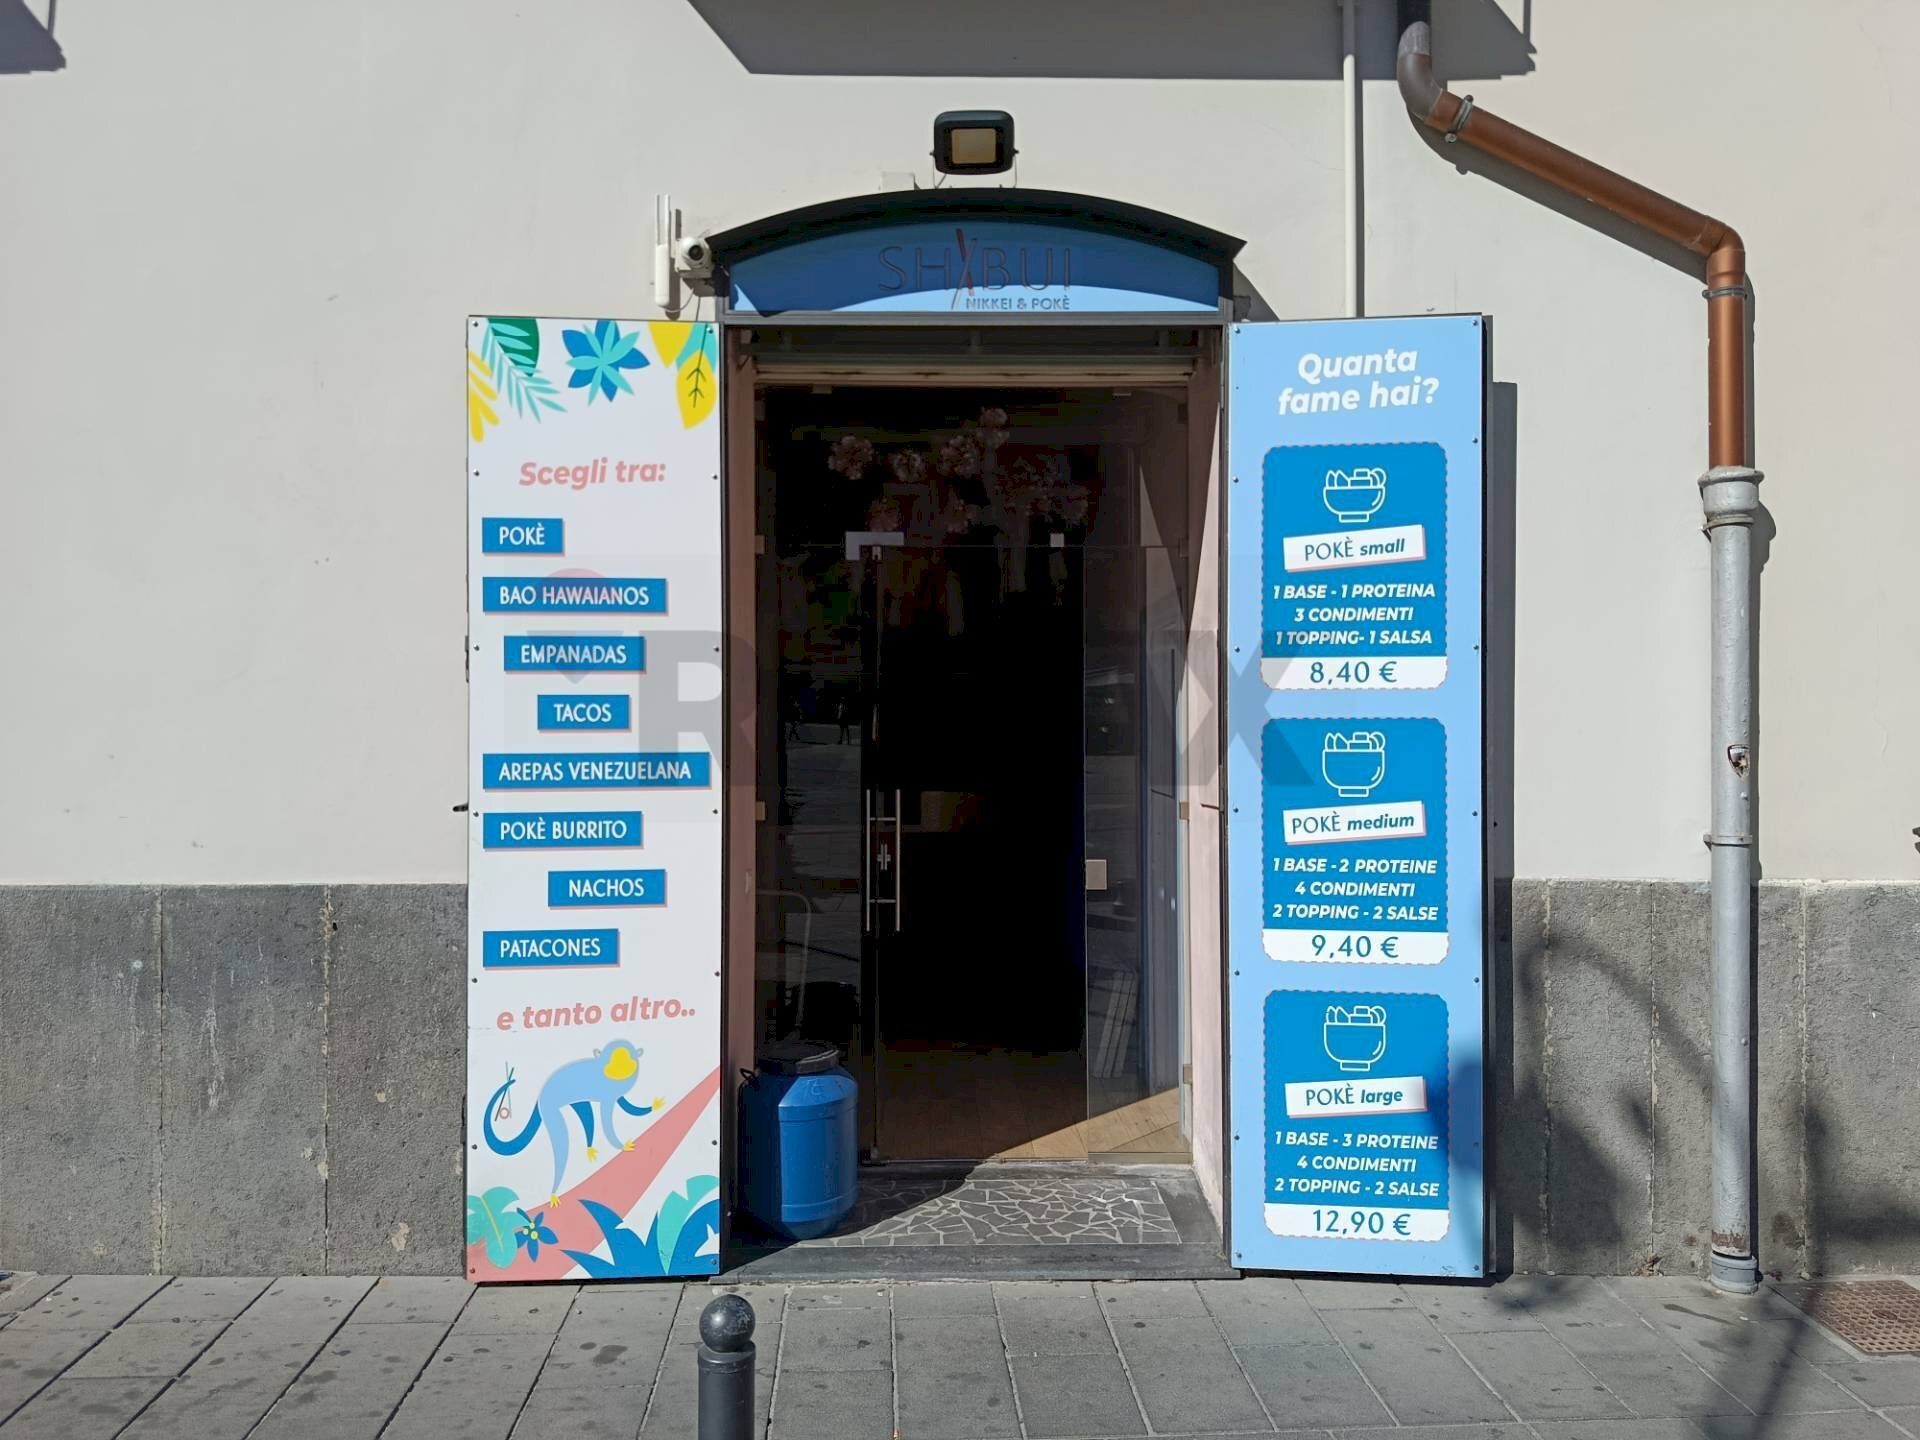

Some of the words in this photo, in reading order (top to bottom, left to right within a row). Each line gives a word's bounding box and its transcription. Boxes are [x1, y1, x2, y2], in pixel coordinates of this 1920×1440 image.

[966, 298, 1012, 309] NIKKEI
[1017, 298, 1027, 309] &
[1032, 295, 1070, 309] POKÈ
[1298, 348, 1417, 384] Quanta
[1278, 387, 1360, 415] fame
[1369, 377, 1440, 408] hai?
[519, 457, 607, 490] Scegli
[616, 460, 666, 483] tra:
[499, 523, 545, 545] POKÈ
[1305, 537, 1354, 561] POKÈ
[1360, 539, 1405, 556] small
[500, 587, 535, 605] BAO
[543, 586, 649, 606] HAWAIANOS
[1273, 585, 1280, 599] 1
[1283, 584, 1327, 599] BASE
[1341, 584, 1348, 598] 1
[1352, 584, 1435, 598] PROTEINA
[1295, 608, 1304, 622] 3
[1308, 607, 1414, 621] CONDIMENTI
[1276, 632, 1283, 645] 1
[1369, 630, 1376, 644] 1
[1380, 630, 1432, 644] SALSA
[521, 644, 627, 664] EMPANADAS
[1310, 661, 1370, 685] 8,40
[1379, 661, 1398, 682] €
[554, 703, 611, 722] TACOS
[499, 762, 563, 781] AREPAS
[569, 761, 691, 781] VENEZUELANA
[500, 817, 546, 840] POKÈ
[552, 820, 627, 839] BURRITO
[1292, 811, 1340, 834] POKÈ
[1348, 814, 1414, 831] medium
[1273, 858, 1280, 871] 1
[1284, 858, 1327, 872] BASE
[1339, 859, 1349, 872] 2
[1355, 859, 1438, 874] PROTEINE
[569, 878, 644, 898] NACHOS
[1295, 882, 1306, 895] 4
[1310, 882, 1415, 896] CONDIMENTI
[1272, 904, 1282, 917] 2
[1287, 904, 1359, 919] TOPPING
[1373, 906, 1382, 919] 2
[1387, 906, 1438, 920] SALSE
[500, 938, 600, 958] PATACONES
[1312, 935, 1371, 959] 9,40
[1380, 936, 1399, 958] €
[497, 1012, 514, 1030] e
[523, 1002, 602, 1029] tanto
[611, 996, 695, 1021] altro..
[1306, 1084, 1354, 1106] POKÈ
[1361, 1088, 1403, 1105] large
[1275, 1132, 1282, 1144] 1
[1286, 1132, 1328, 1146] BASE
[1342, 1134, 1352, 1146] 3
[1357, 1134, 1438, 1150] PROTEINE
[1297, 1156, 1307, 1169] 4
[1312, 1156, 1416, 1172] CONDIMENTI
[1274, 1178, 1284, 1191] 2
[1289, 1178, 1361, 1194] TOPPING
[1374, 1181, 1384, 1195] 2
[1388, 1181, 1440, 1197] SALSE
[1313, 1209, 1384, 1235] 12,90
[1393, 1213, 1411, 1236] €
